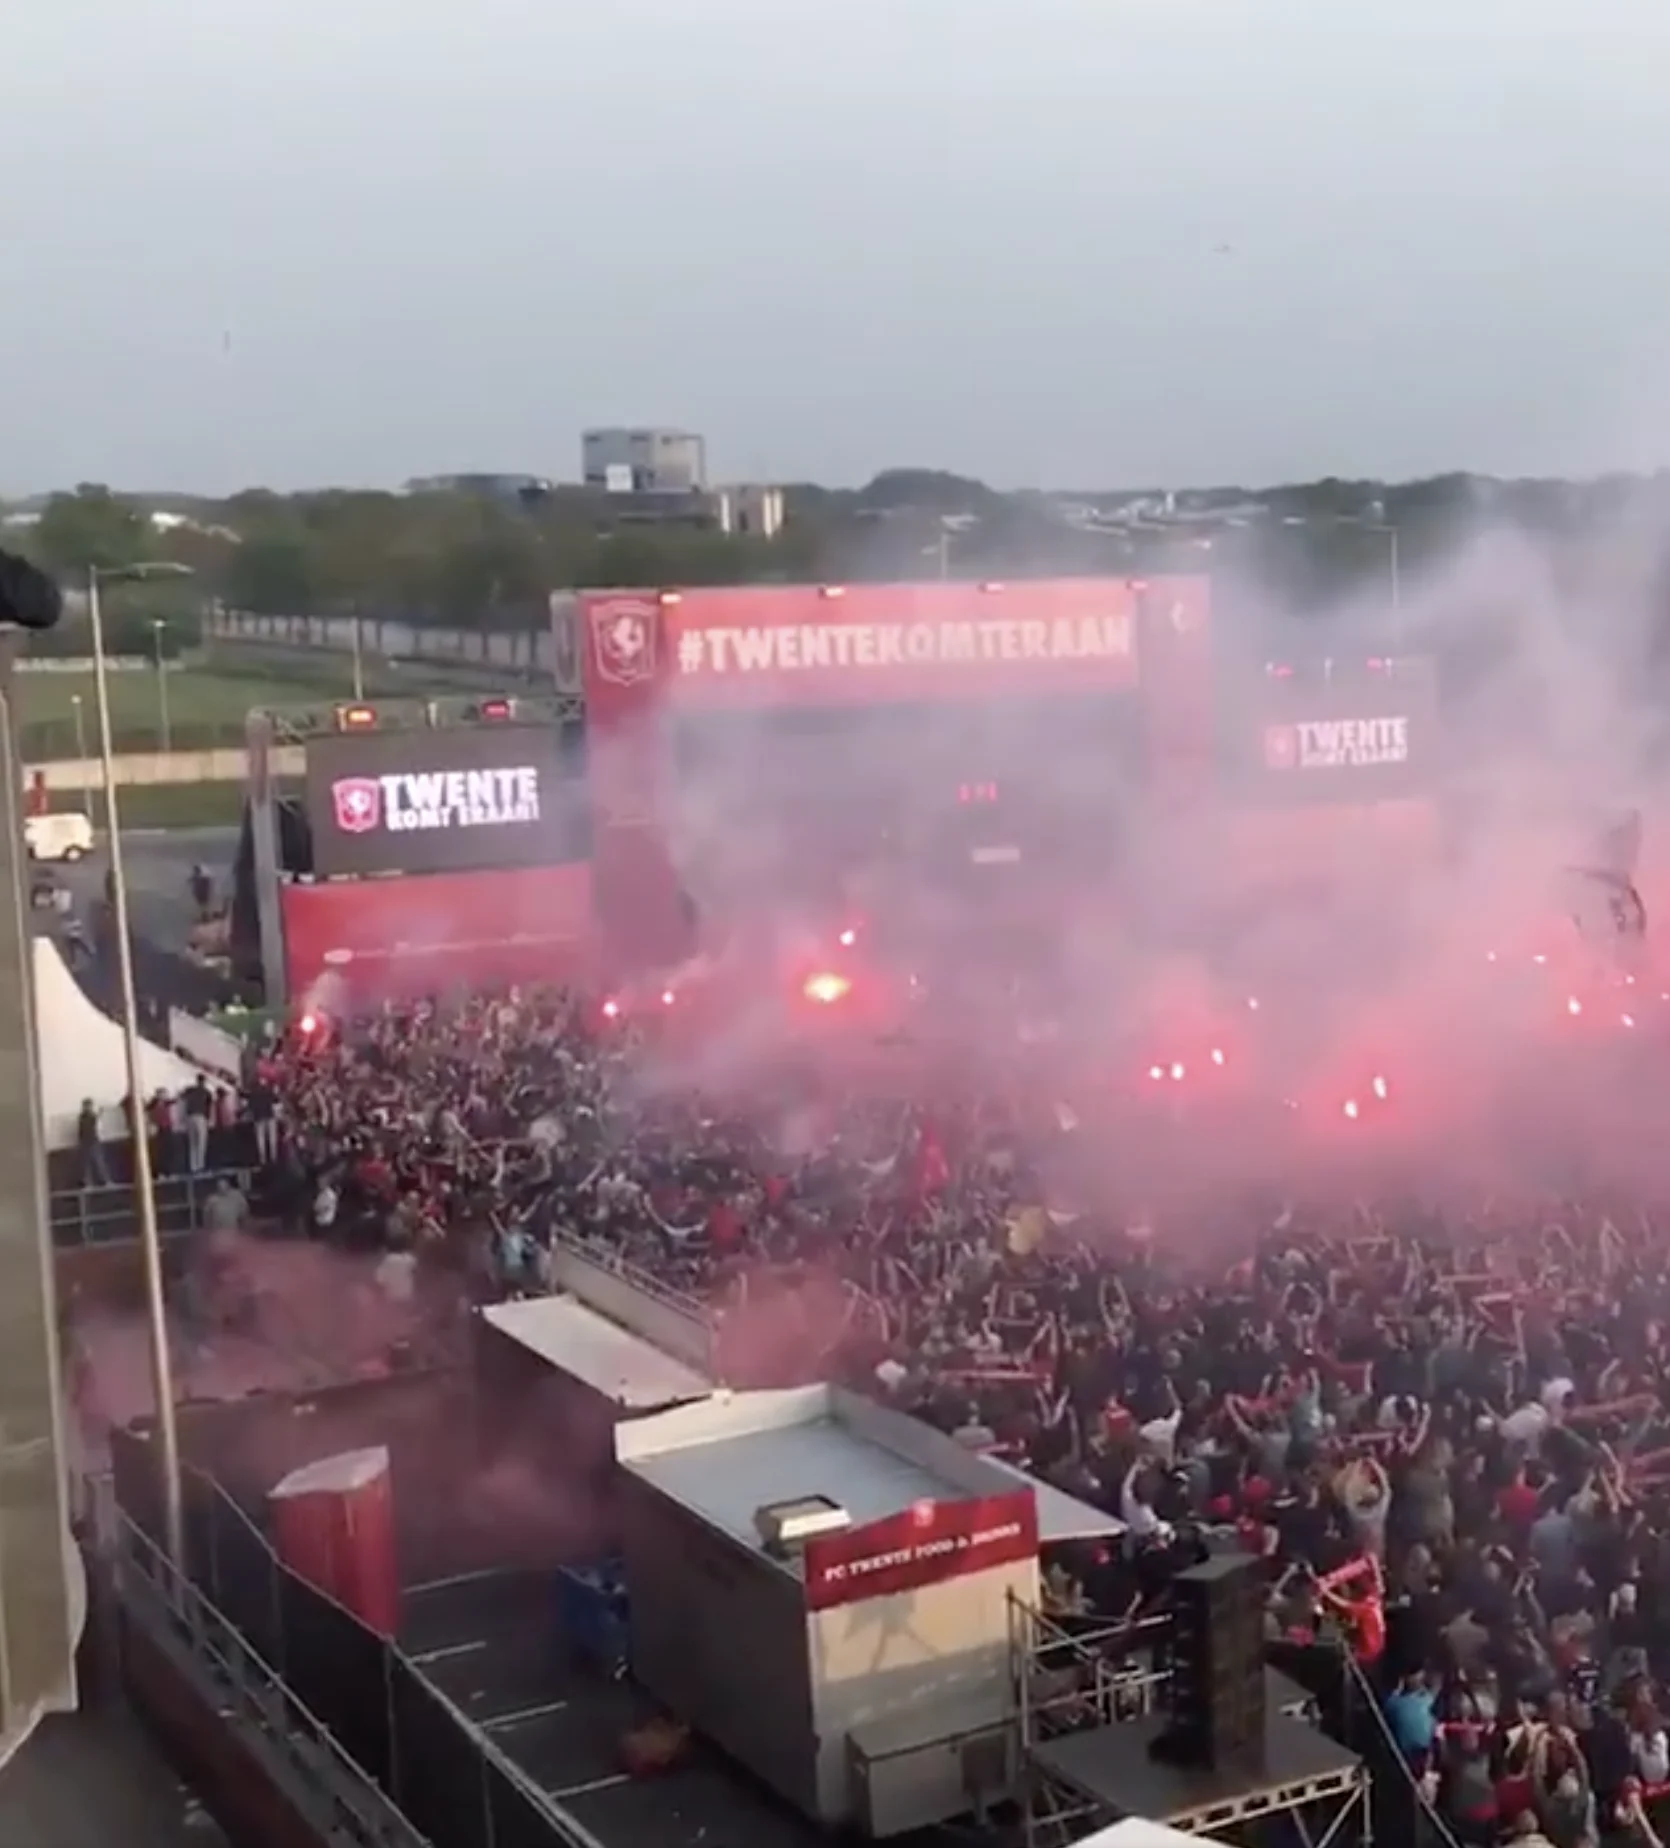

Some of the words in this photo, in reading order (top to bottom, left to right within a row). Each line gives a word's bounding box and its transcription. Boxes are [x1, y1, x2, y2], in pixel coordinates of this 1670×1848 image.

[678, 616, 1130, 674] #TWENTEKOMTERAAN
[1297, 717, 1407, 752] TWENTE
[380, 767, 538, 808] TWENTE
